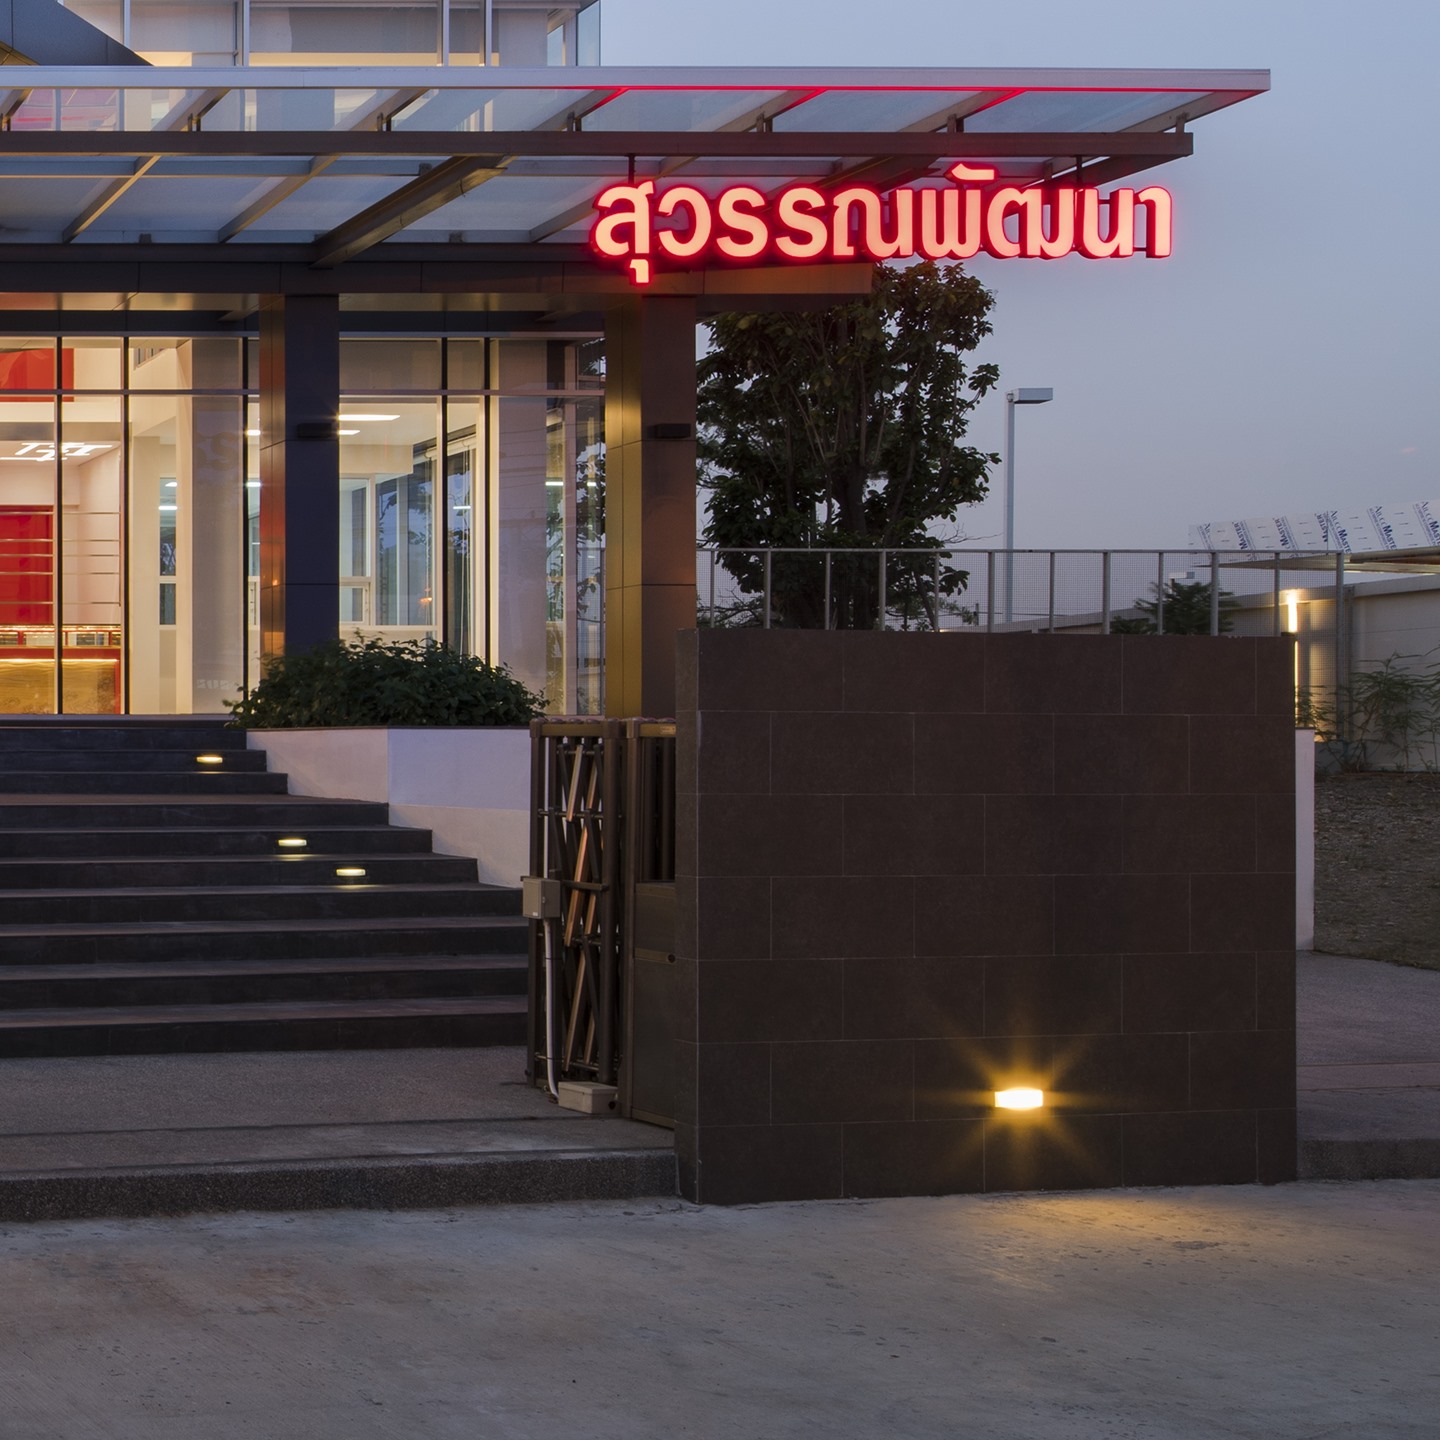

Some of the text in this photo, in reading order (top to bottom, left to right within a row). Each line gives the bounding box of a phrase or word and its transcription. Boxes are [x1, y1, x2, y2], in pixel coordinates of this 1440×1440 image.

[592, 162, 1174, 285] สุวรรณพัฒนา
